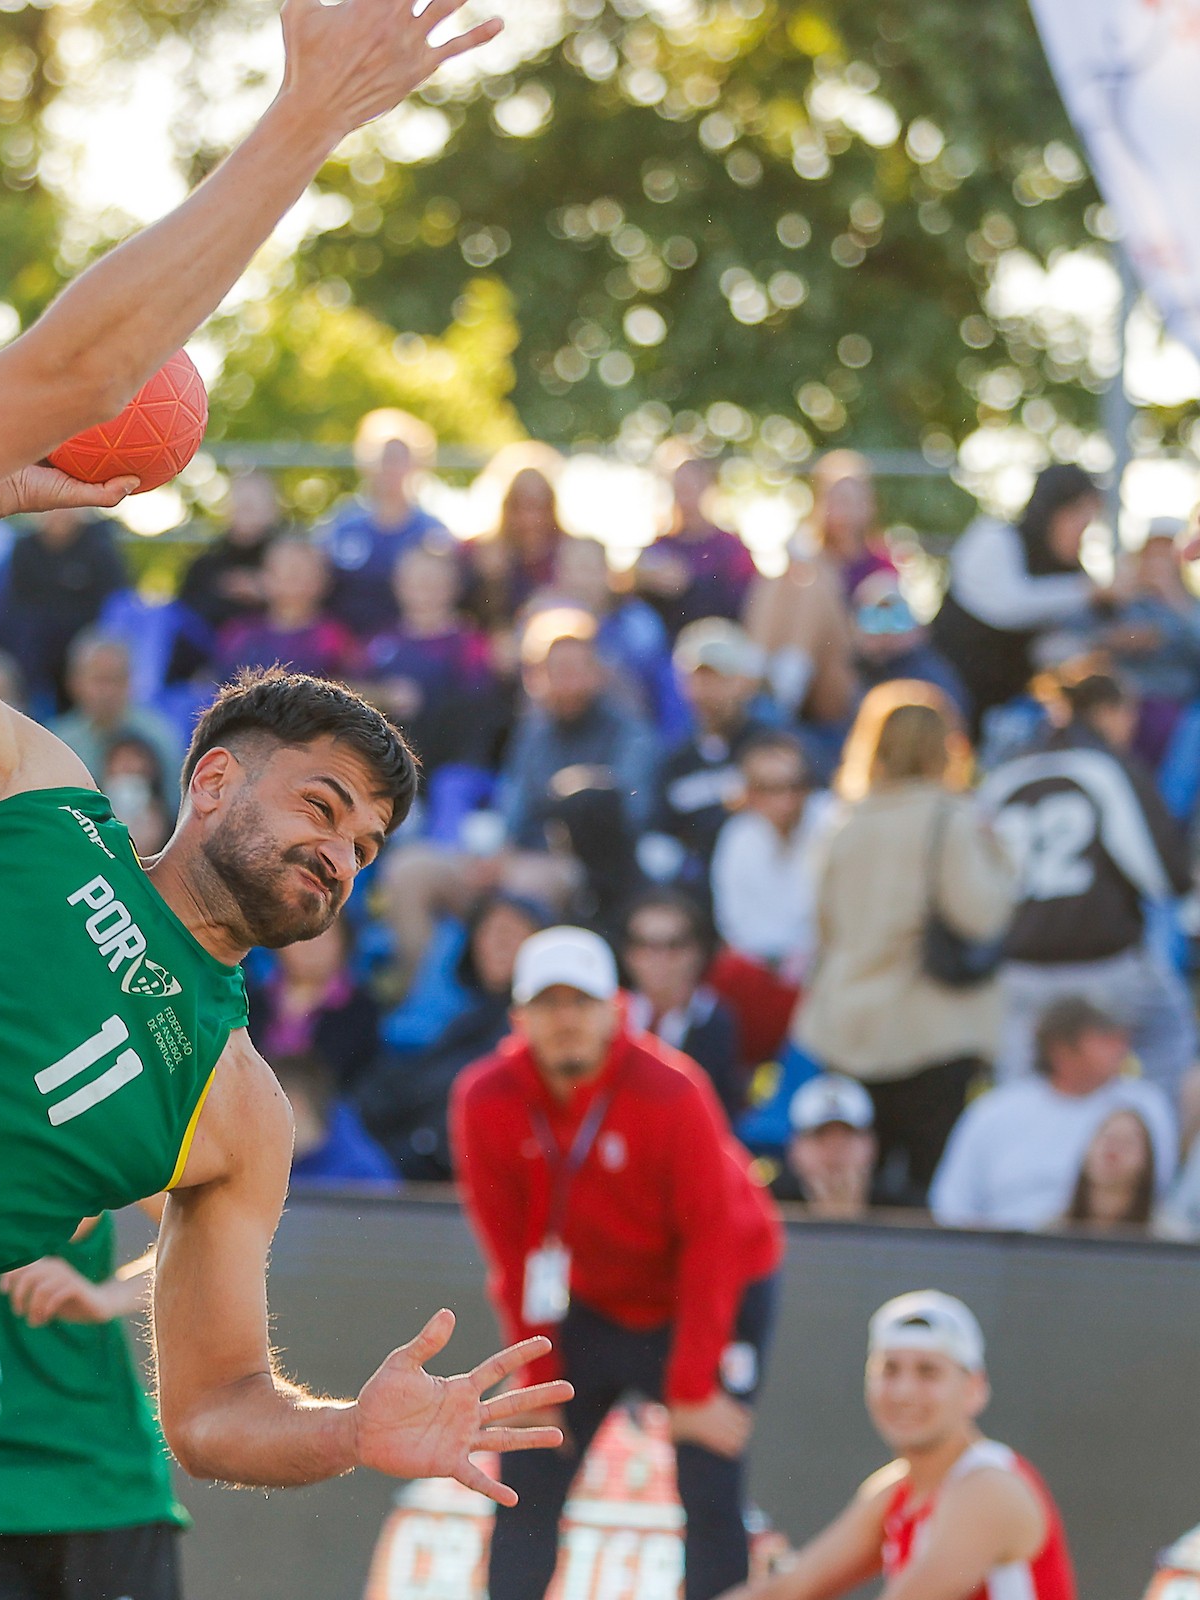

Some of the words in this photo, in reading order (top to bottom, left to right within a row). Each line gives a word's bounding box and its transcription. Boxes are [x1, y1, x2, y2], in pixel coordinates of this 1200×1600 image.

[66, 873, 148, 974] POR
[146, 1018, 159, 1033] DE
[153, 1031, 176, 1076] PORTUGAL
[155, 1012, 167, 1027] DE
[161, 1026, 184, 1066] ANDEBOL
[164, 1005, 193, 1056] FEDERAÇÃO
[33, 1013, 145, 1128] 11
